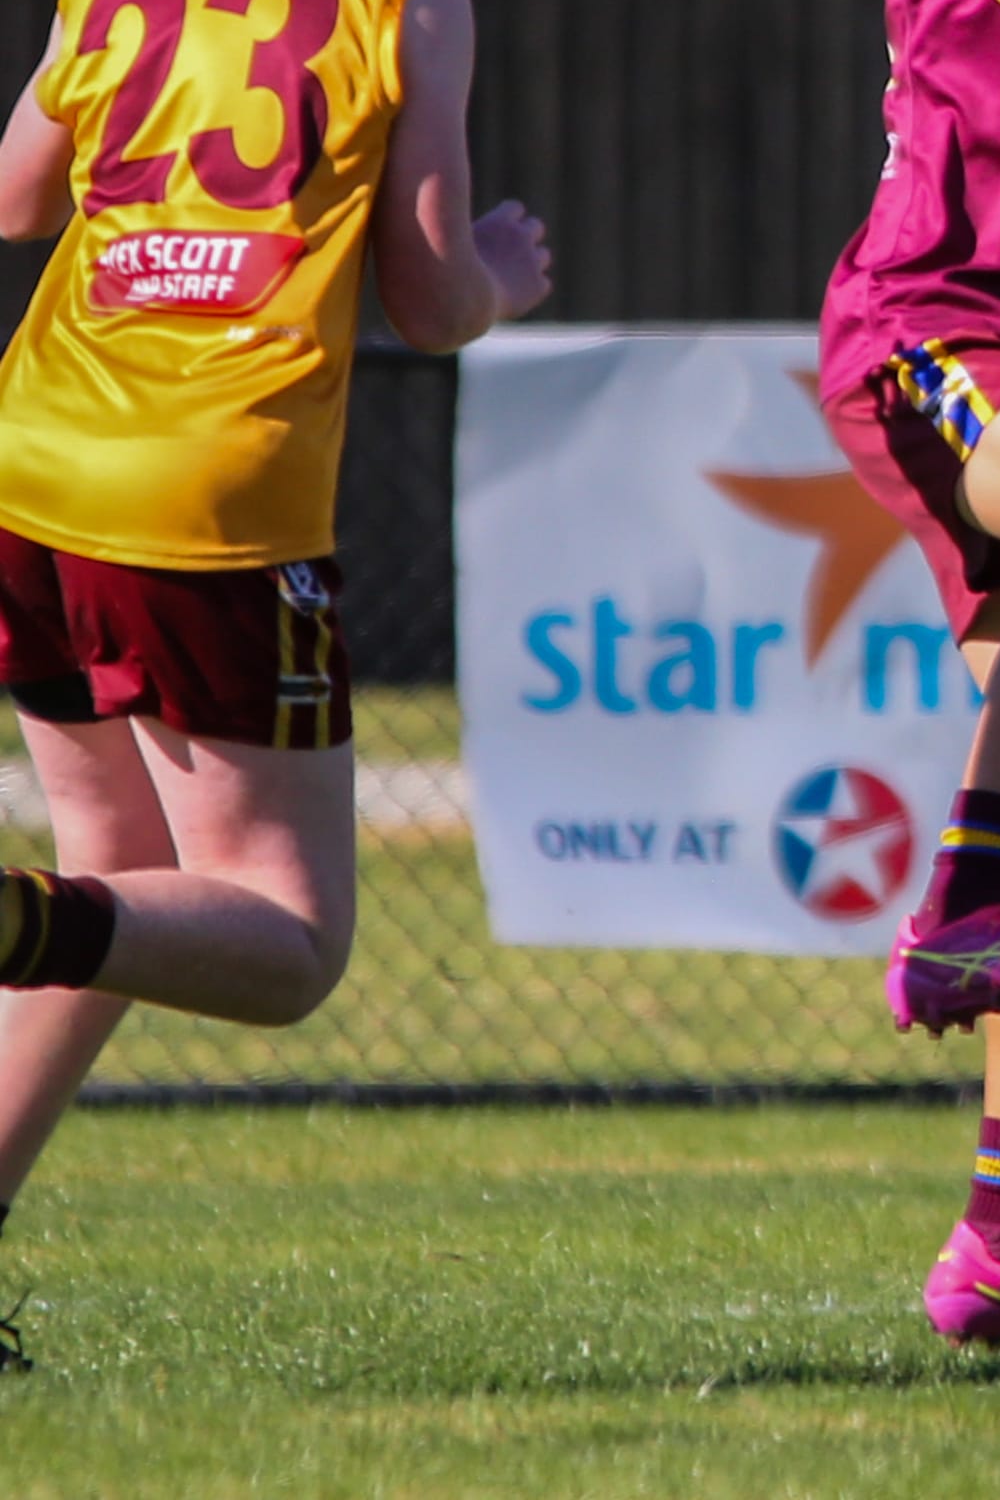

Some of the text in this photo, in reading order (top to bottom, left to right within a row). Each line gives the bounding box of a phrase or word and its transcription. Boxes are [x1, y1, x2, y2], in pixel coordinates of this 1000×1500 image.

[146, 234, 250, 272] SCOTT
[159, 272, 236, 301] STAFF
[522, 594, 784, 714] star
[534, 817, 738, 865] ONLY AT
